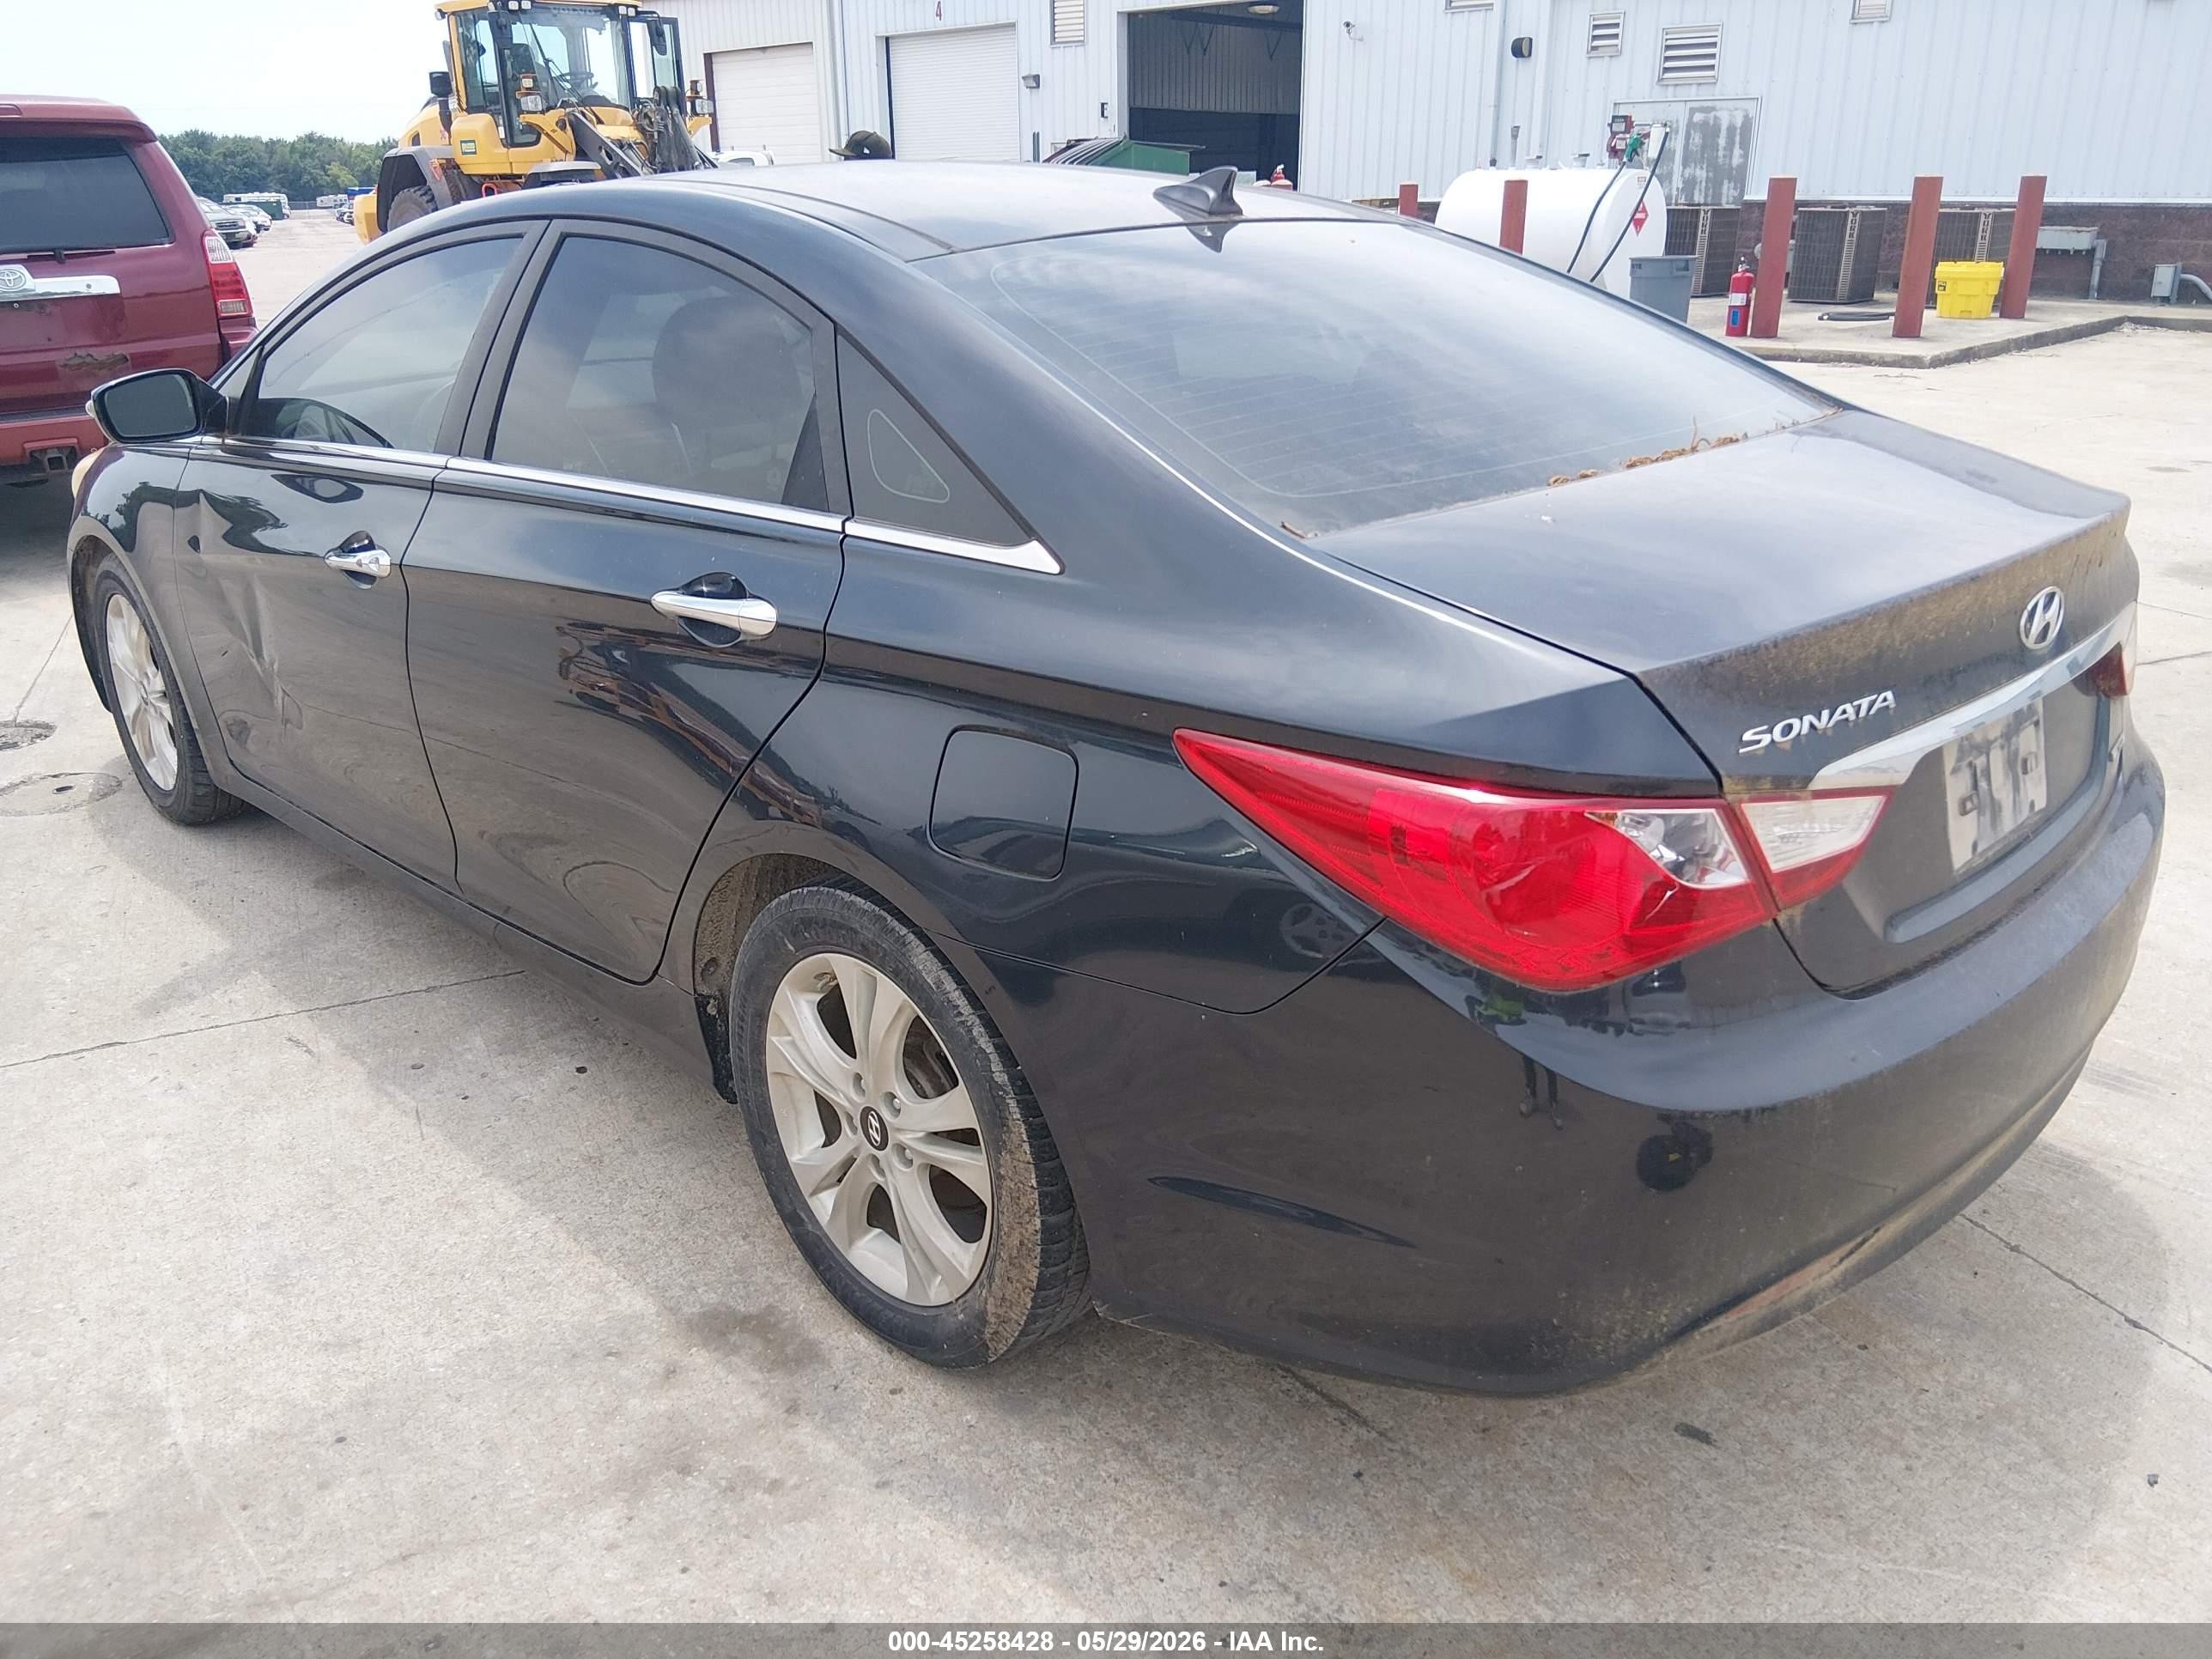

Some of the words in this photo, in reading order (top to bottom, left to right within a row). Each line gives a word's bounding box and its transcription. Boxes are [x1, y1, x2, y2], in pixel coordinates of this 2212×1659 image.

[935, 1, 943, 21] 4
[1847, 211, 1860, 240] YORK
[1980, 212, 1992, 241] YORK
[1738, 690, 1896, 754] SONATA
